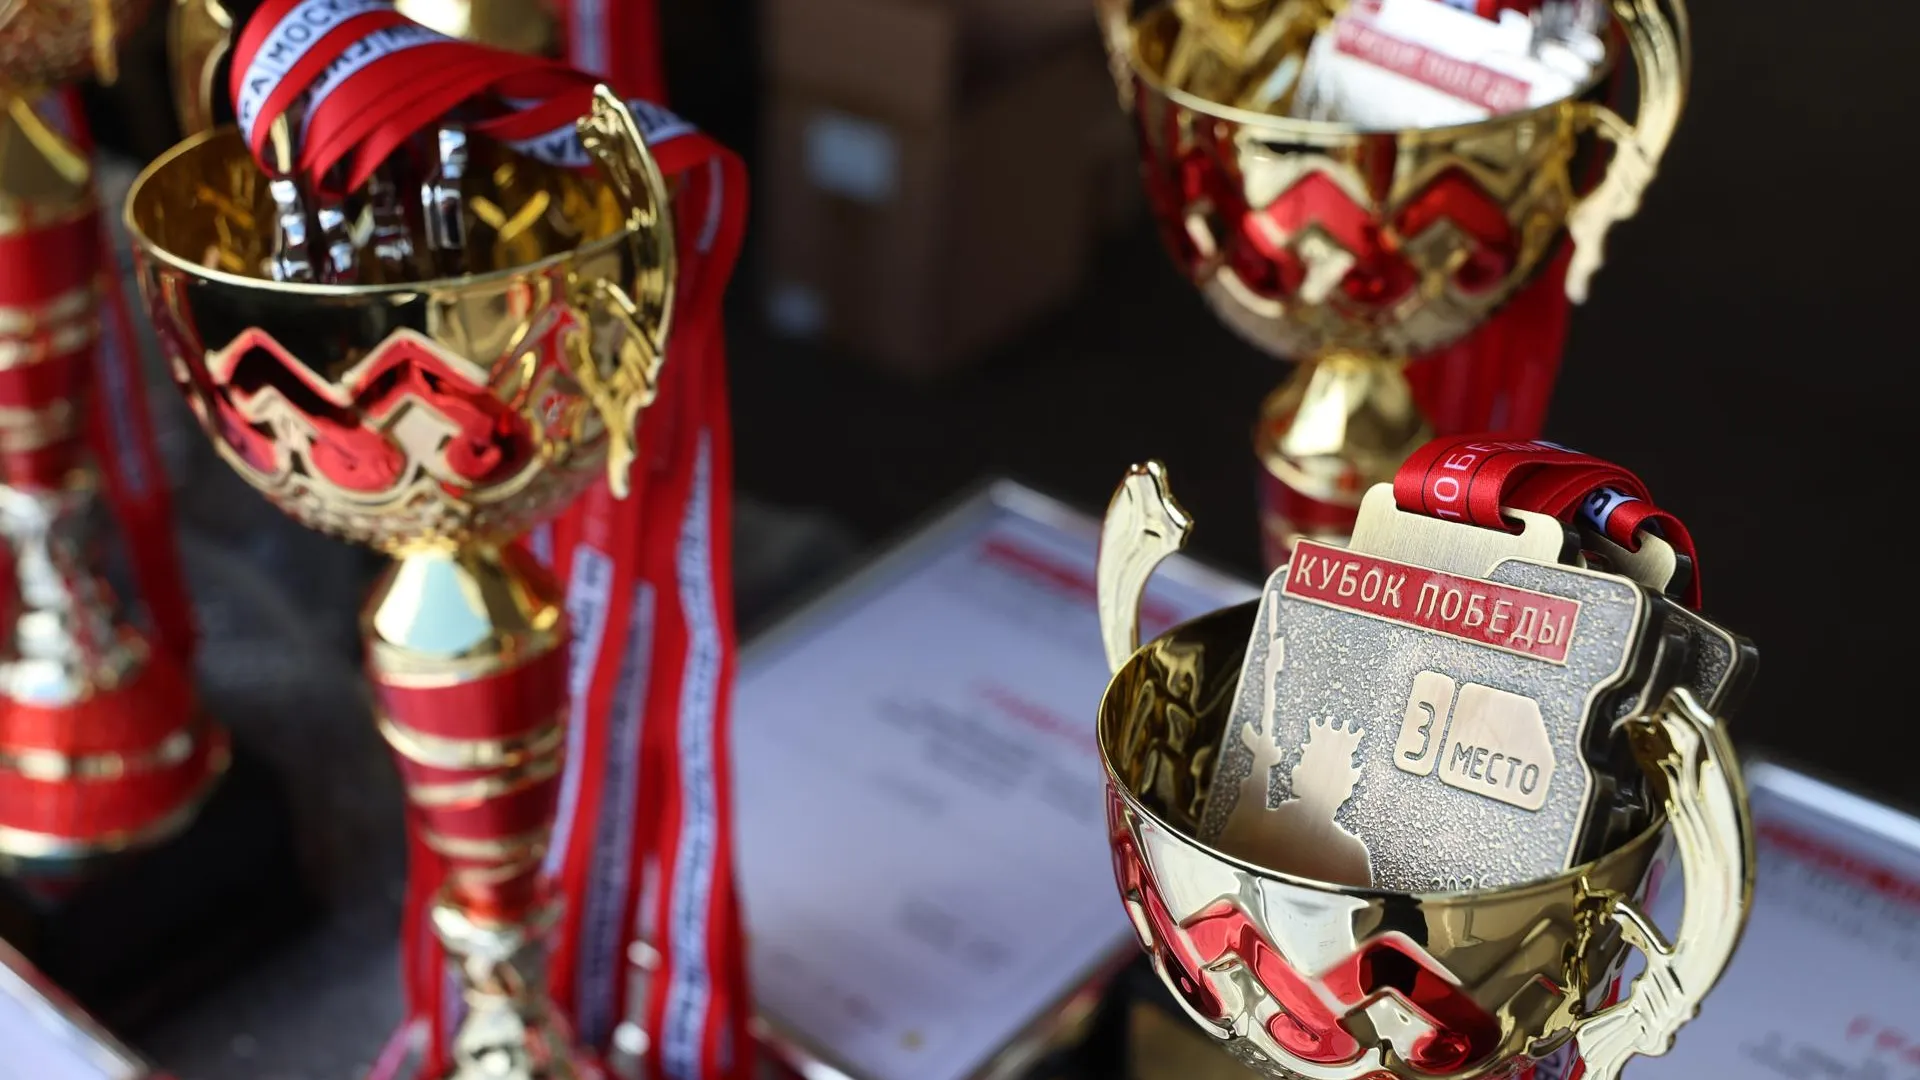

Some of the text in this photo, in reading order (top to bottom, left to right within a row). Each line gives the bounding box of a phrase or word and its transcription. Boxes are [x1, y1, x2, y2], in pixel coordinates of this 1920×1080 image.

[1293, 552, 1568, 649] КУБОК ПОБЕДЫ
[1403, 700, 1540, 796] 3 МЕСТО
